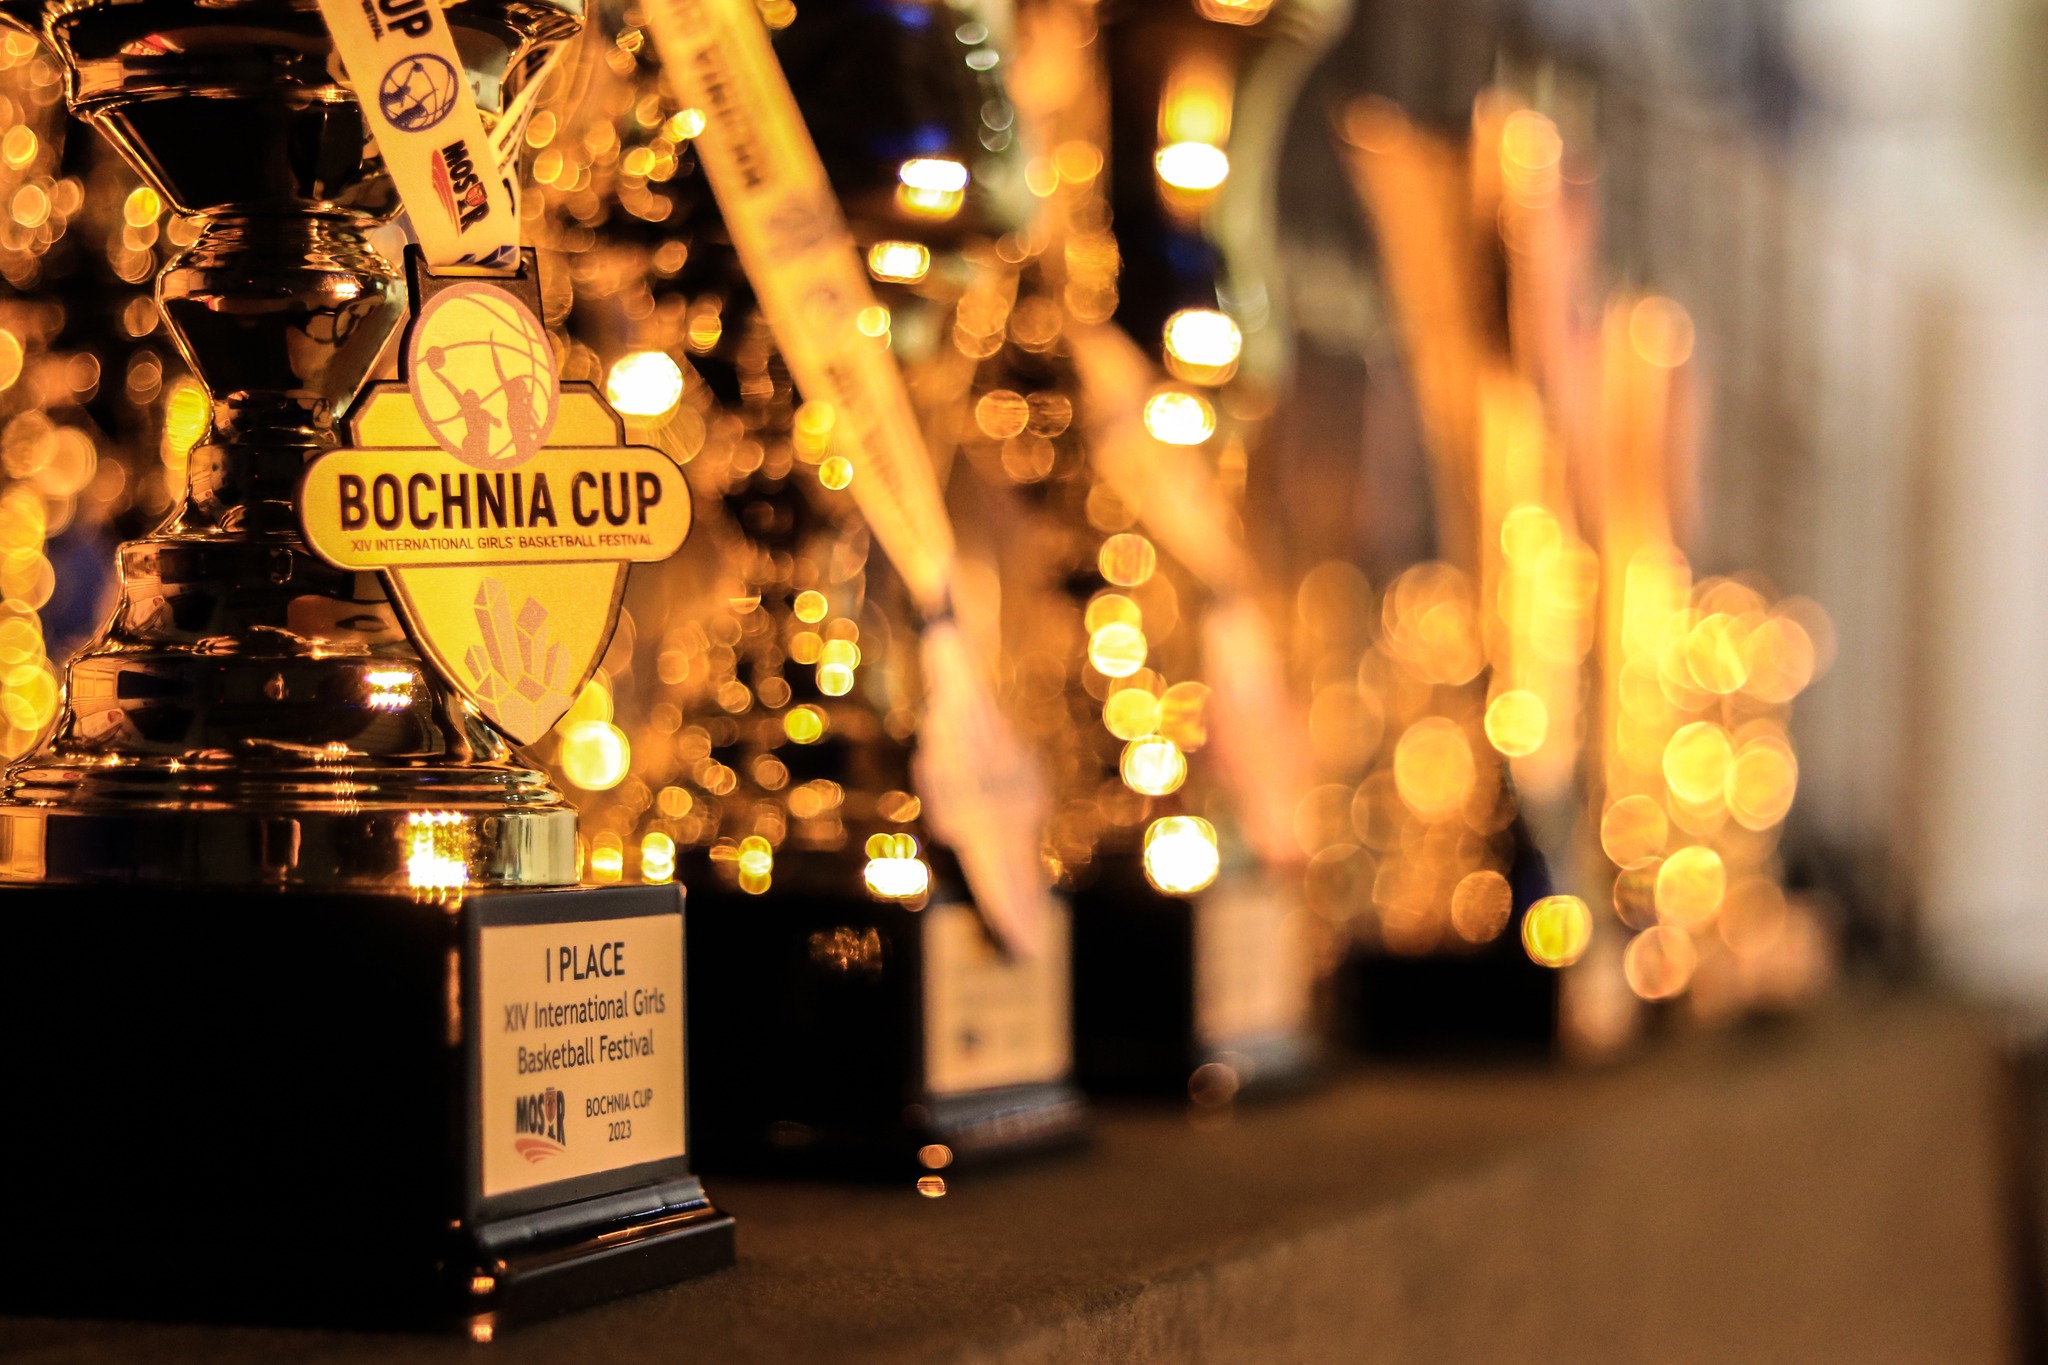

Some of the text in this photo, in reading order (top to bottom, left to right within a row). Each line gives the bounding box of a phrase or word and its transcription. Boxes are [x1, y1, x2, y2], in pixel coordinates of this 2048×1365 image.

[361, 0, 384, 42] ESTIVAL
[379, 0, 433, 39] UP
[338, 471, 663, 532] BOCHNIA CUP
[351, 539, 372, 552] XIV
[376, 536, 475, 551] INTERNATIONAL
[519, 533, 596, 549] BASKETBALL
[599, 532, 654, 547] FESTIVAL
[546, 941, 625, 983] I PLACE
[503, 987, 666, 1033] XIV International Girls
[517, 1029, 655, 1075] Basketball Festival
[586, 1088, 654, 1118] BOCHNIA CUP
[608, 1119, 632, 1142] 2023
